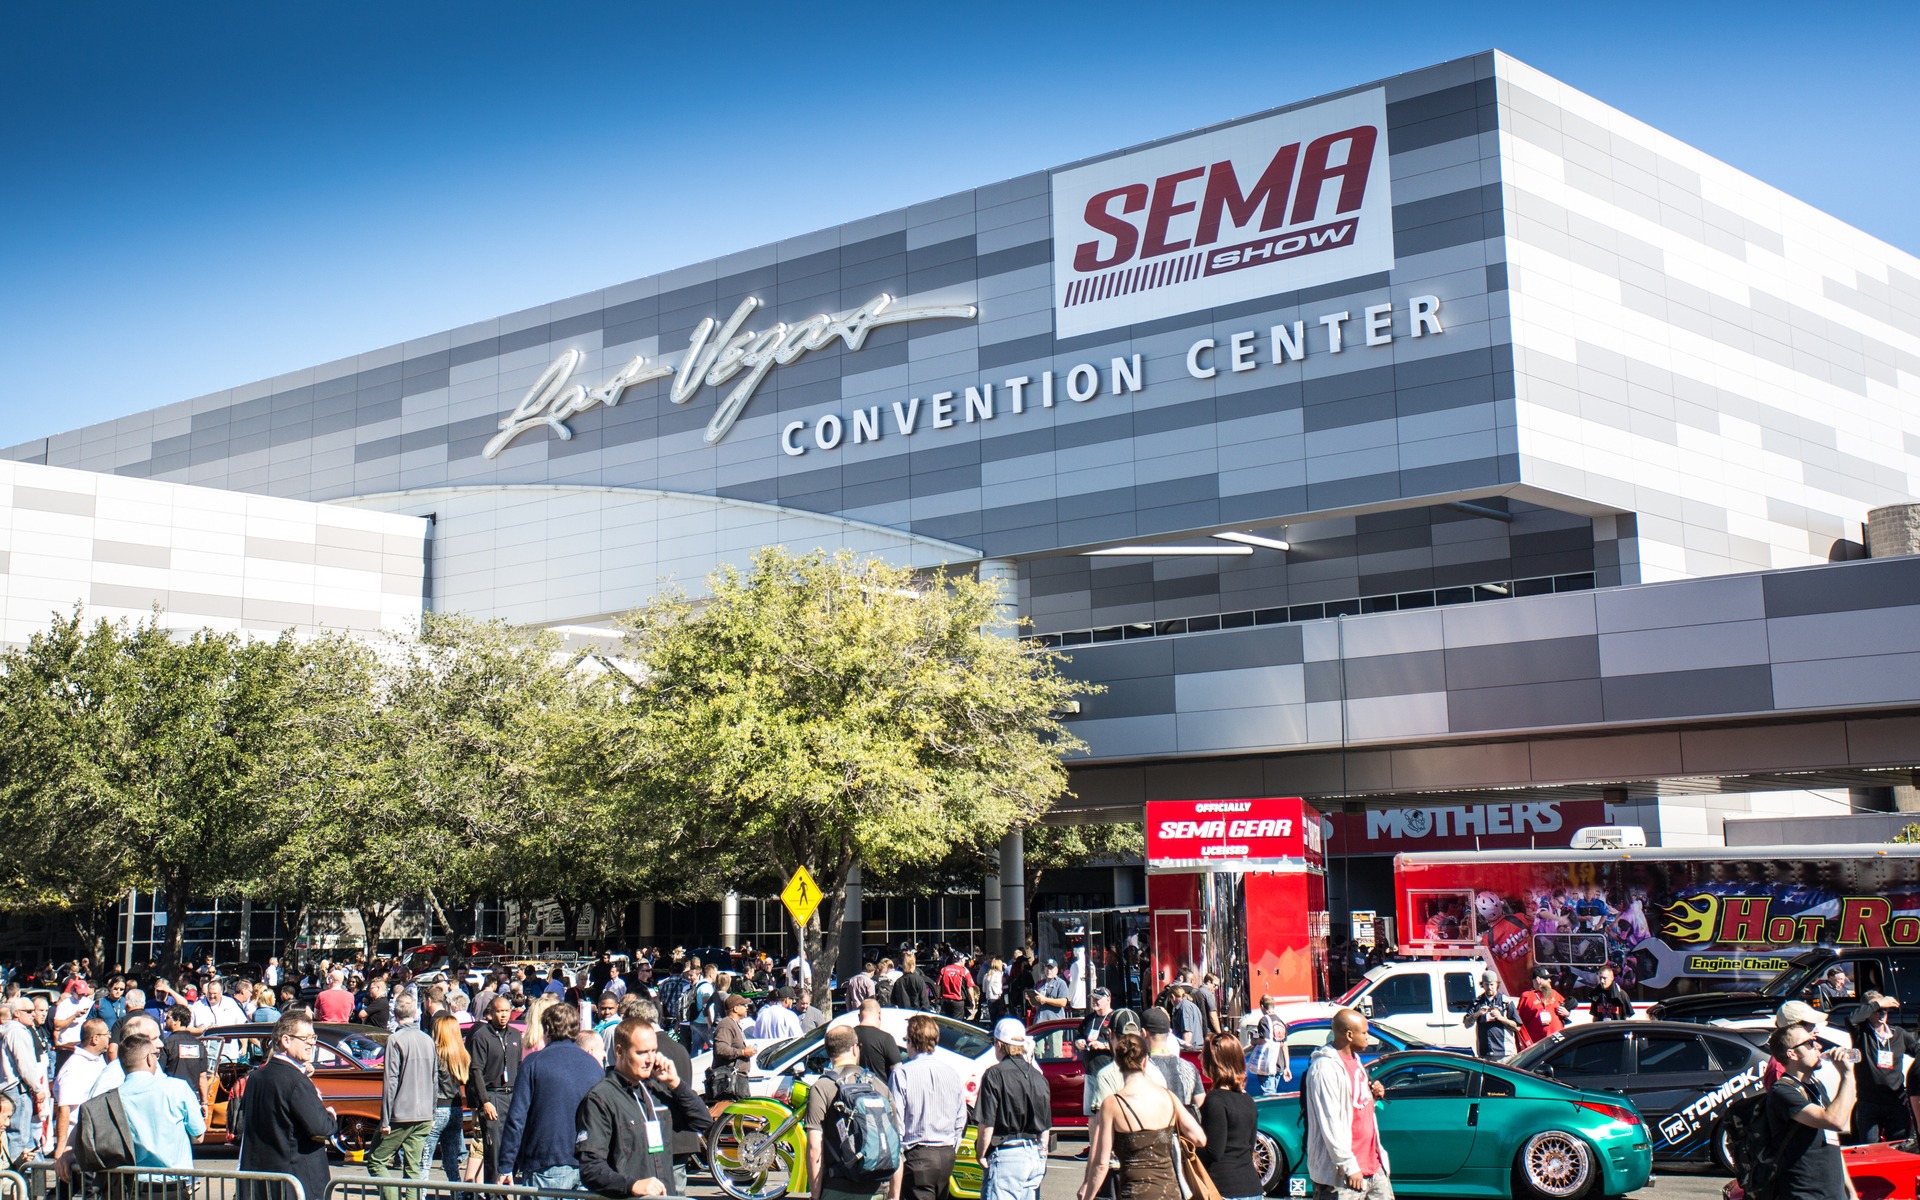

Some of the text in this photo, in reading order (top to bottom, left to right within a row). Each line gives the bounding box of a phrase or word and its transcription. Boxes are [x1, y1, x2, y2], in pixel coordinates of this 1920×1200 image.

[1073, 125, 1378, 272] SEMA
[1211, 223, 1352, 269] SHOW
[482, 293, 977, 459] Las Vegas
[781, 294, 1444, 457] CONVENTION CENTER
[1195, 802, 1252, 813] OFFICIALLY
[1366, 802, 1563, 839] MOTHERS
[1158, 820, 1226, 839] SEMA
[1229, 819, 1292, 838] GEAR
[1201, 845, 1249, 856] LICENSED
[1491, 928, 1529, 956] Motive
[1690, 956, 1789, 972] Engine Challe
